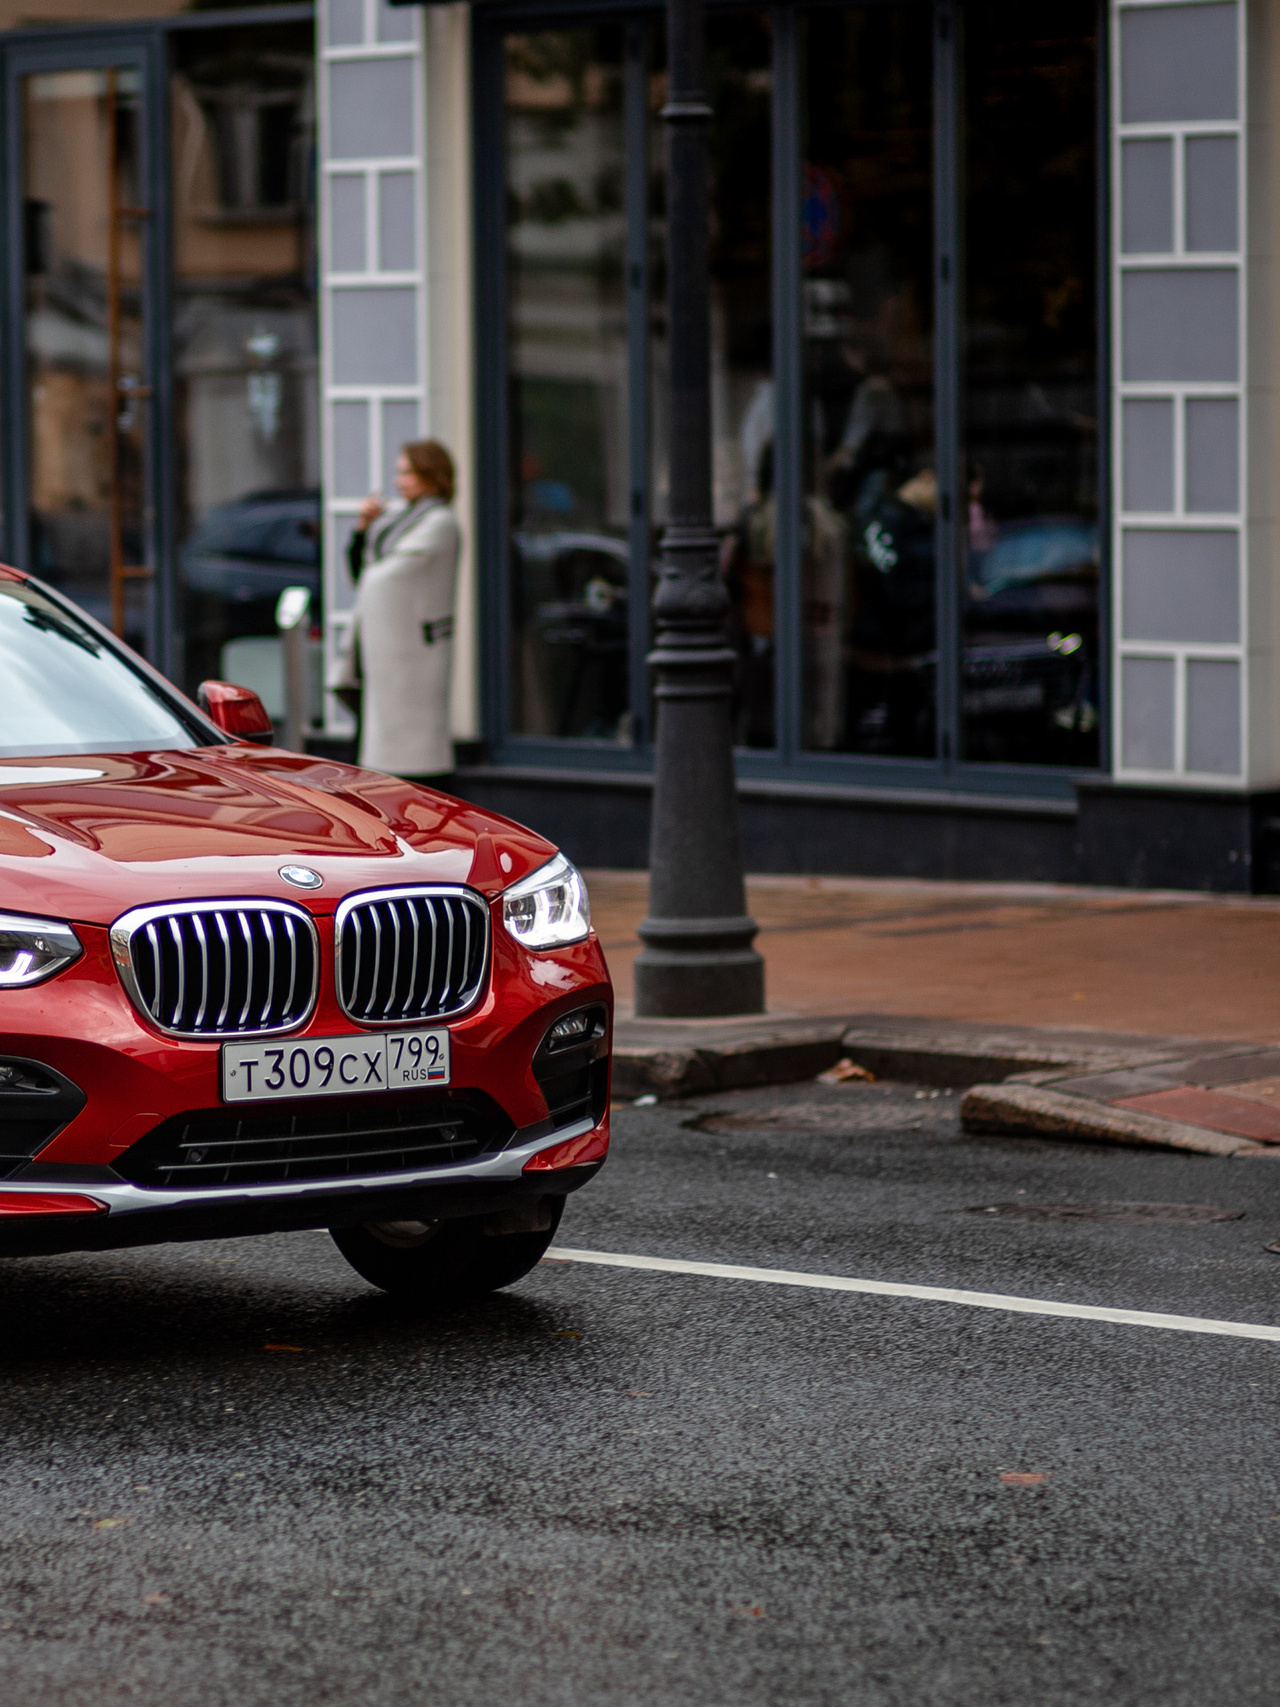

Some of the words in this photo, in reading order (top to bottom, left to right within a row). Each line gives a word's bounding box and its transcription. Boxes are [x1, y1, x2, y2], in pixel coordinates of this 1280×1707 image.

[240, 1046, 382, 1092] T309CX
[390, 1034, 440, 1069] 799
[403, 1069, 426, 1081] RUS
